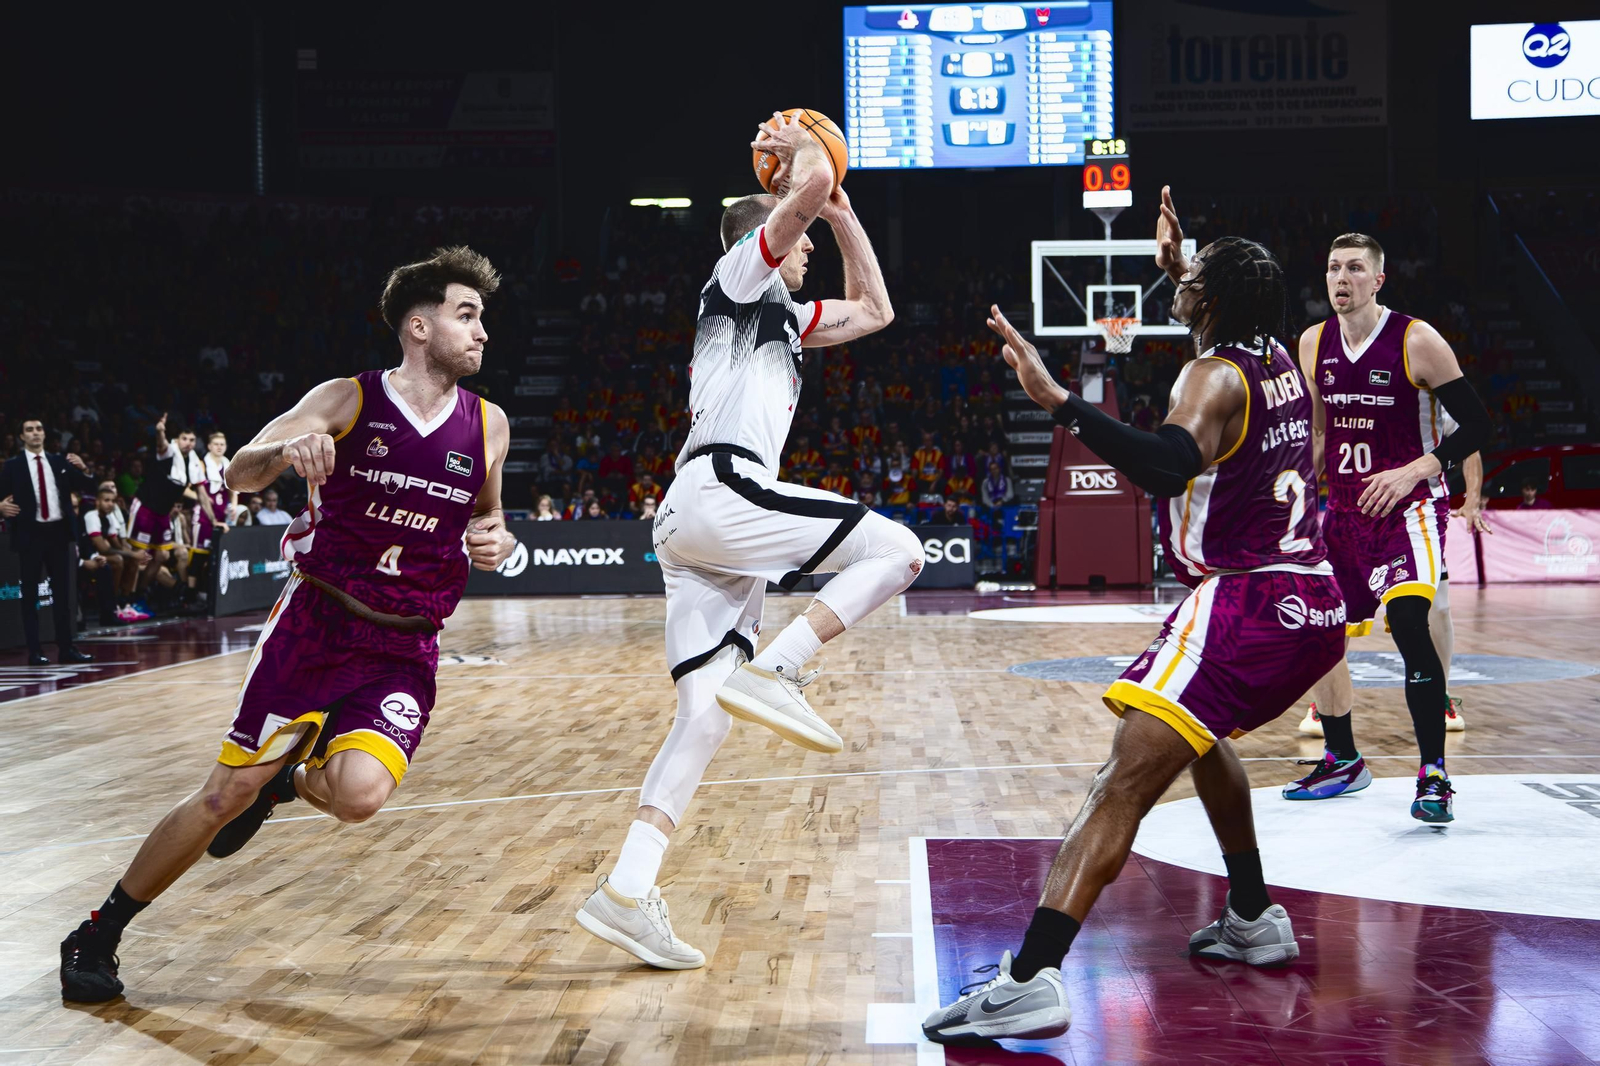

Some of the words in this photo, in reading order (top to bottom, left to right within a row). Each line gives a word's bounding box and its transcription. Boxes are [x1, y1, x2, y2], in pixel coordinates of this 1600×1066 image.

[1167, 20, 1349, 85] torrente
[960, 86, 998, 109] 8:13
[1092, 139, 1126, 155] 8:13
[1083, 163, 1130, 192] 0.9
[1338, 442, 1372, 474] 20
[1070, 470, 1117, 490] PONS
[365, 501, 439, 533] LLEIDA
[1273, 469, 1314, 554] 2
[376, 544, 404, 577] 4
[533, 547, 625, 566] NAYOX
